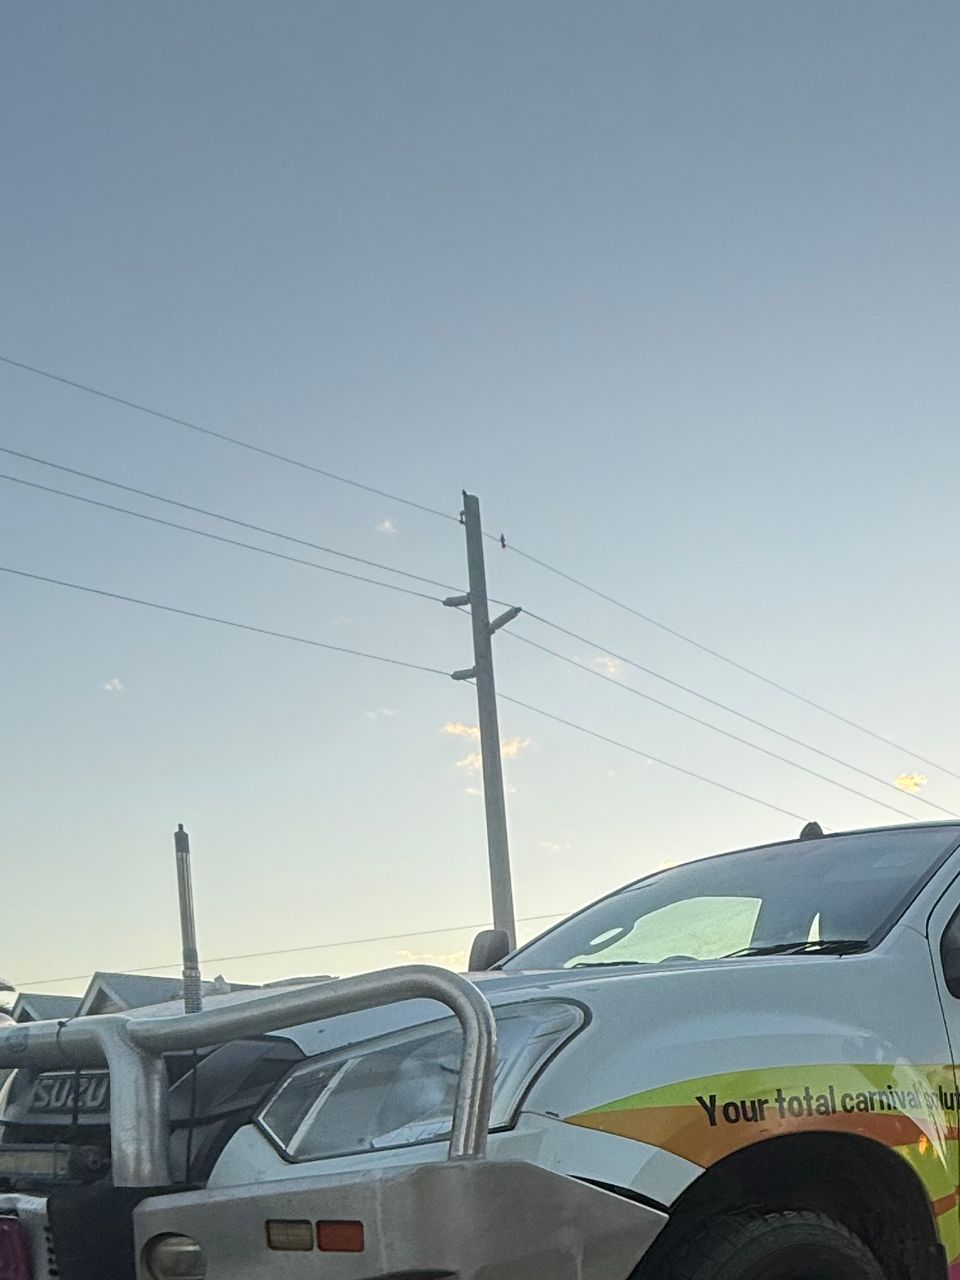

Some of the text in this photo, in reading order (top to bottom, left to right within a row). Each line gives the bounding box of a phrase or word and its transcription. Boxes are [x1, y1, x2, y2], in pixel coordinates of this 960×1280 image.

[695, 1094, 769, 1126] Your
[775, 1085, 837, 1119] total
[841, 1080, 922, 1113] carnival
